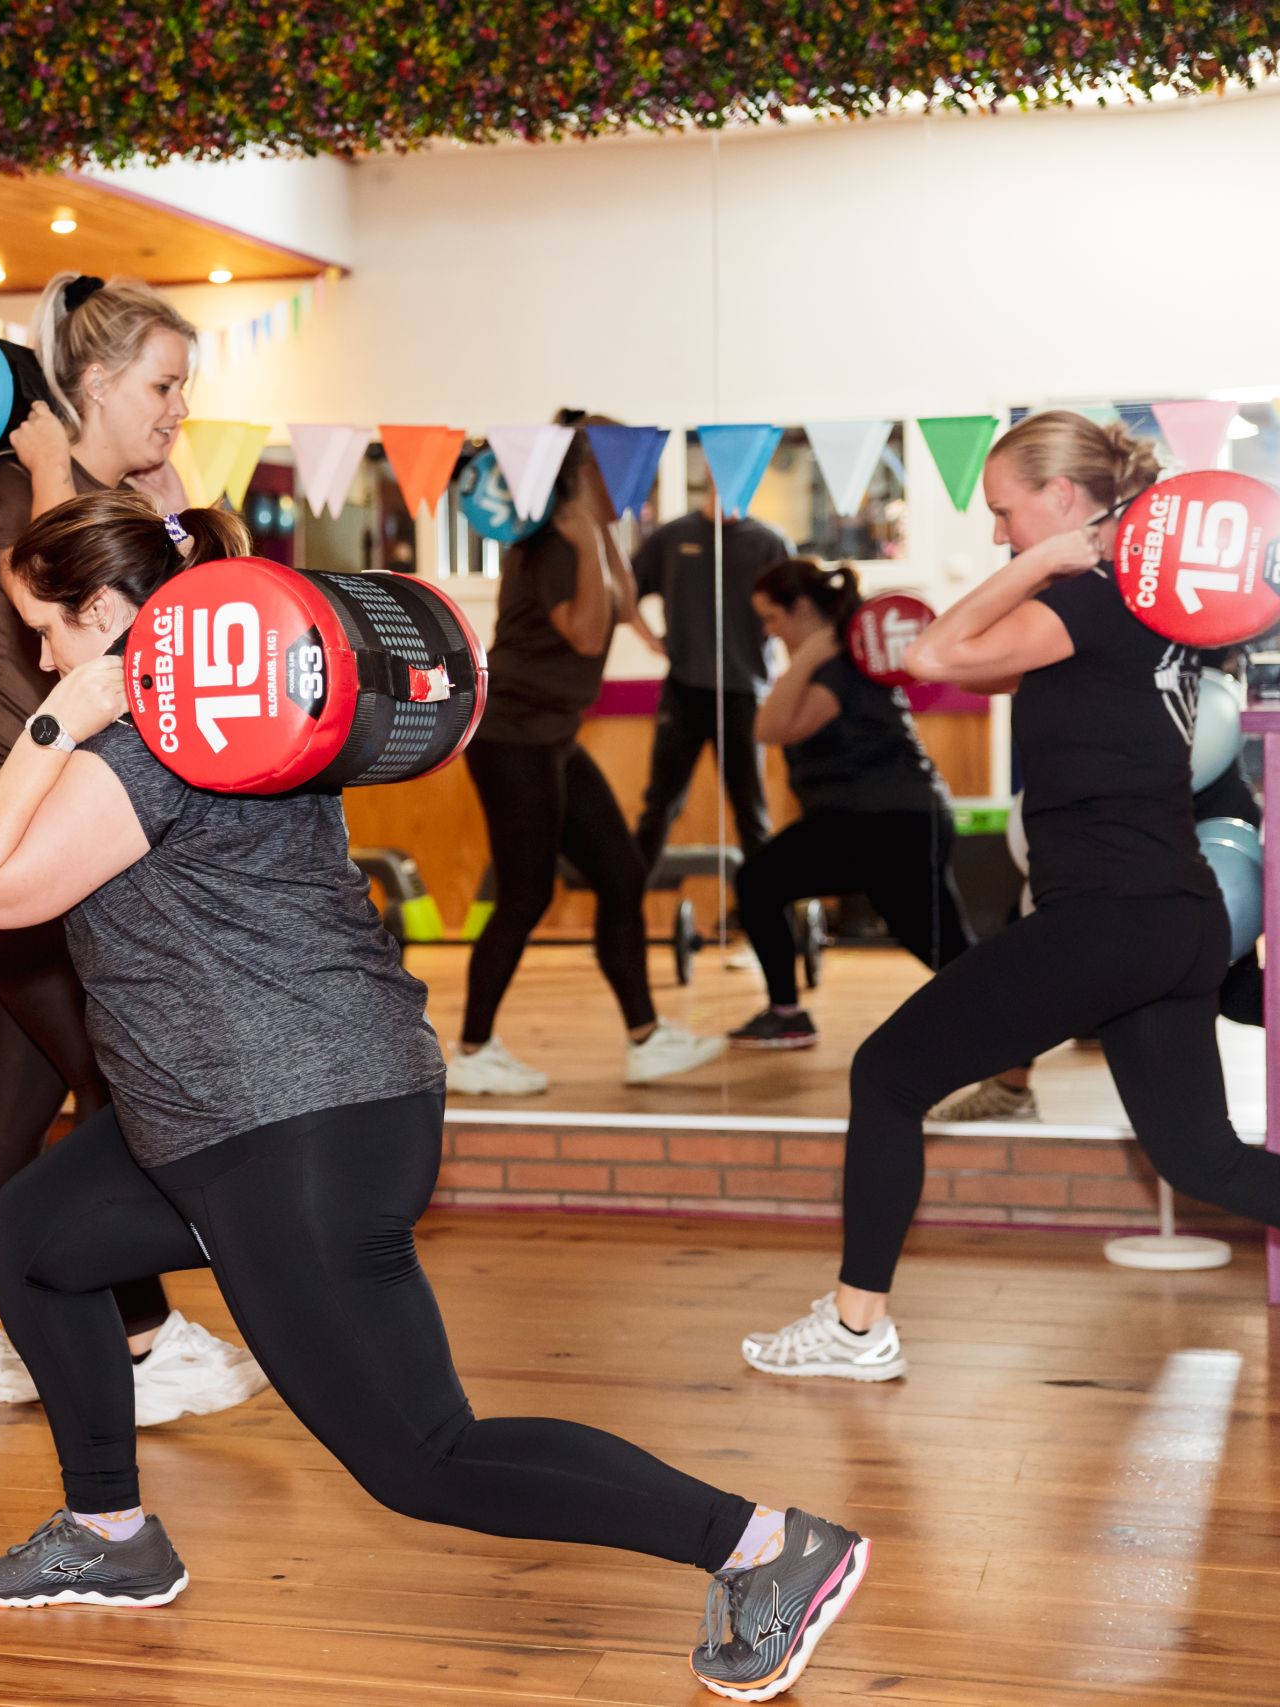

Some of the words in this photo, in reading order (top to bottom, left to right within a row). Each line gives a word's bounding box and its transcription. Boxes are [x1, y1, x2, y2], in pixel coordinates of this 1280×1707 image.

[1175, 500, 1248, 615] 15
[132, 679, 142, 698] NOT
[193, 601, 261, 754] 15
[299, 646, 323, 699] 33
[137, 699, 146, 713] DO
